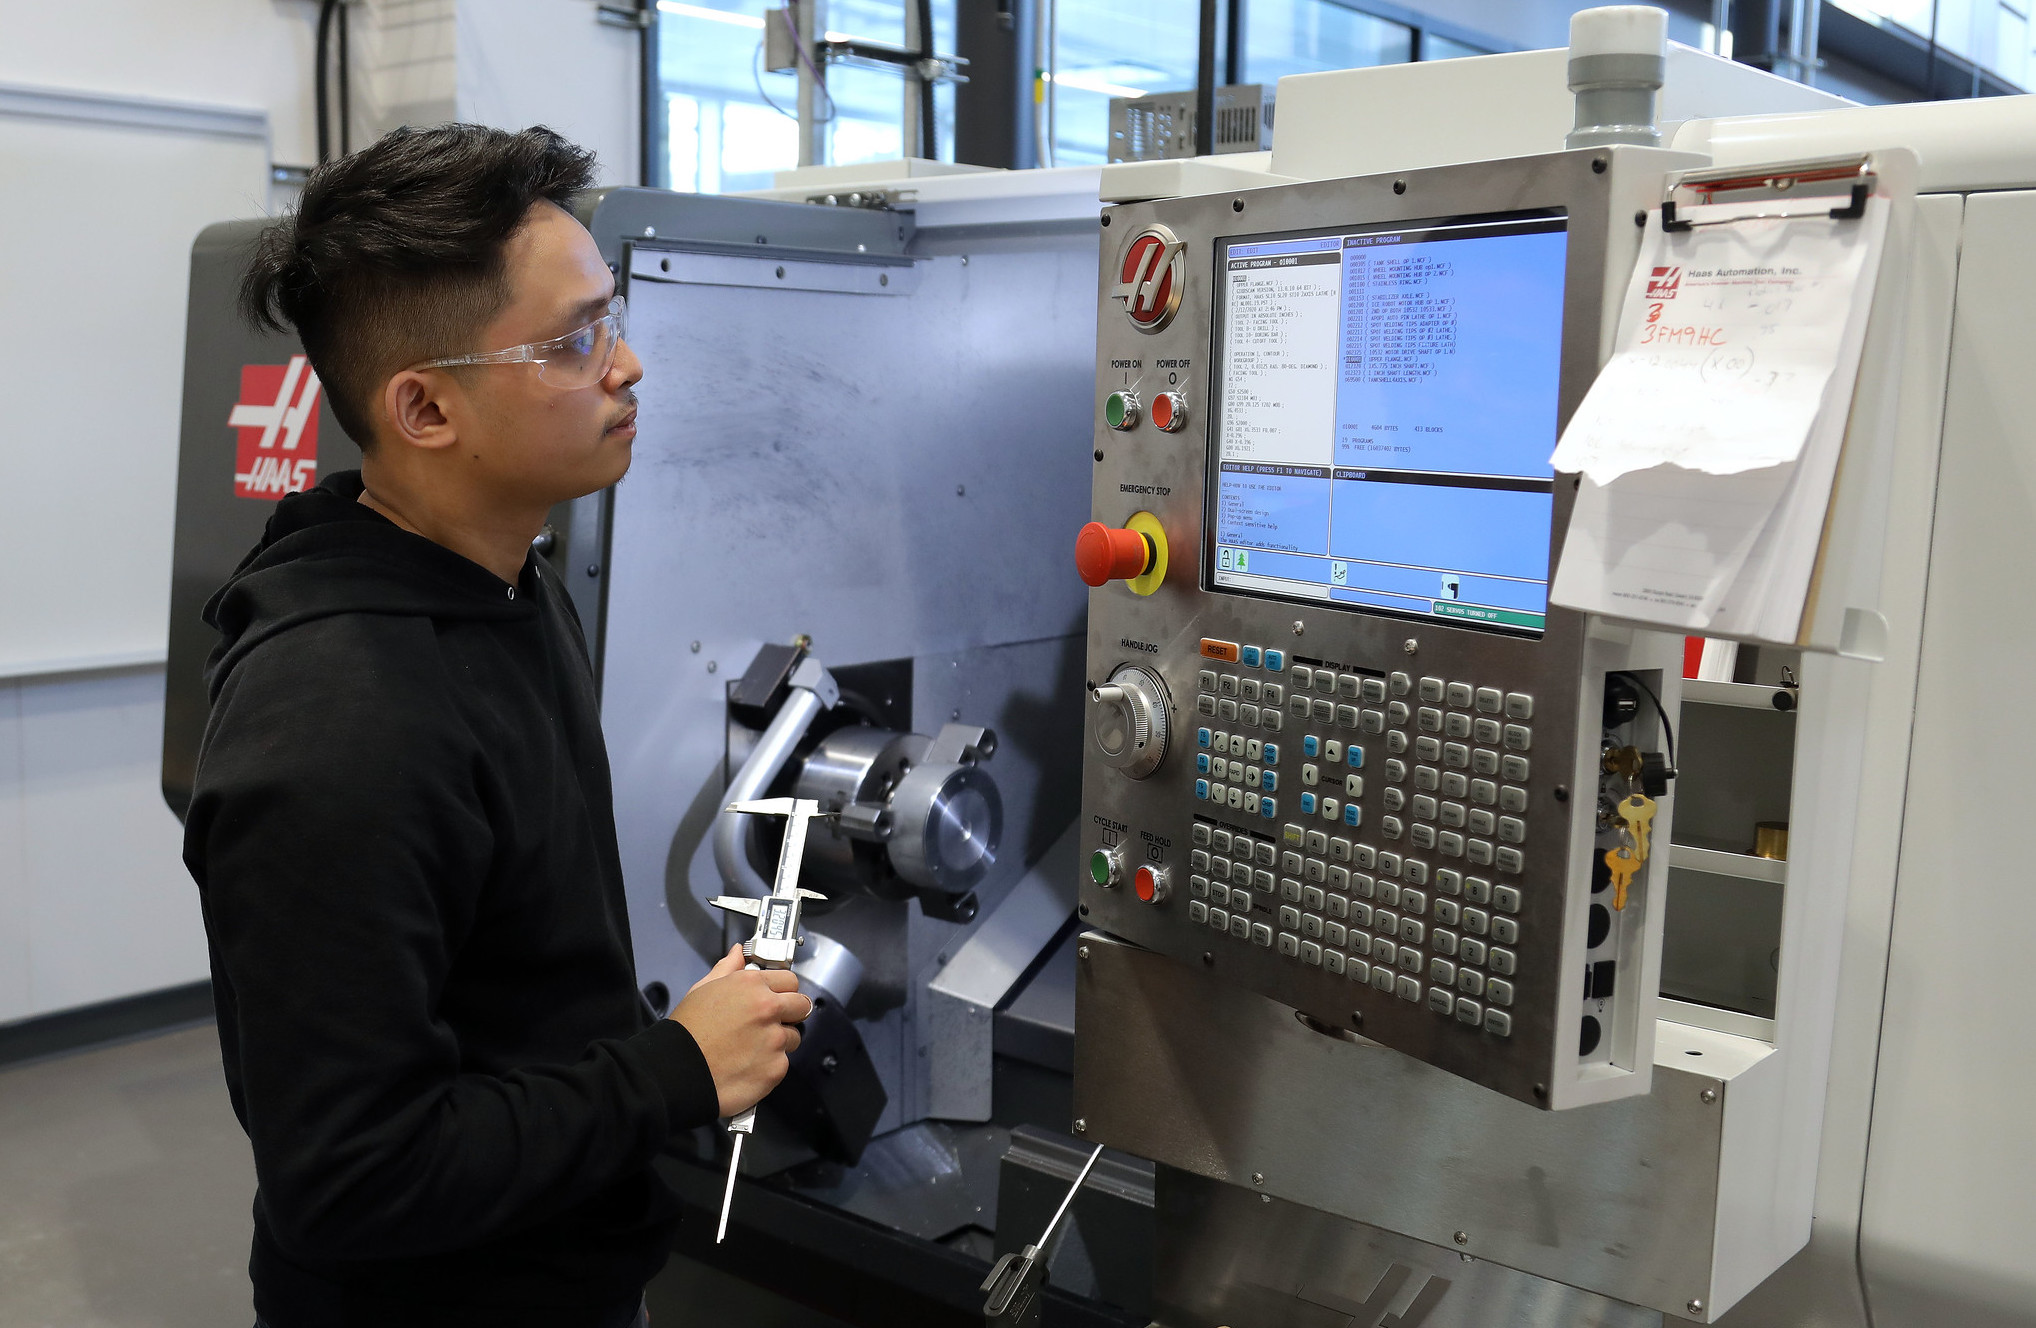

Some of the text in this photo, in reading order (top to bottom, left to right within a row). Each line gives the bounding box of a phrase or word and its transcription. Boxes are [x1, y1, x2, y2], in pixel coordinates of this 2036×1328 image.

[1347, 238, 1373, 246] INACTIVE
[1231, 261, 1248, 269] ACTIVE
[1250, 259, 1272, 267] PROGRAM
[1688, 267, 1802, 278] Haas Automation, Inc.
[1646, 289, 1678, 299] HAAS
[1641, 324, 1728, 346] 3FM9HC
[1111, 359, 1142, 368] POWER ON
[1156, 359, 1190, 368] POWER OFF
[235, 457, 317, 493] HAAS
[1256, 466, 1274, 474] (PRESS
[1294, 468, 1322, 477] NAVIGATE)
[1120, 484, 1171, 496] EMERGENCY STOP
[1446, 606, 1465, 615] SERVOS
[1467, 609, 1486, 617] TURNED
[1487, 611, 1497, 619] OFF
[1121, 639, 1158, 654] HANDLE JOG
[1207, 645, 1227, 656] RESET
[1325, 661, 1351, 672] DISPLAY
[1203, 677, 1209, 685] F1
[1224, 681, 1230, 689] F2
[1245, 686, 1252, 694] F3
[1267, 690, 1275, 698] F4
[1322, 776, 1342, 786] CURSOR
[1094, 815, 1128, 833] CYCLE START
[1220, 822, 1248, 835] OVERRIDES
[1140, 831, 1171, 848] FEED HOLD
[1285, 832, 1299, 841] SHIFT
[1360, 853, 1366, 862] C
[1385, 860, 1390, 868] D
[1311, 867, 1316, 875] G
[1411, 868, 1416, 876] E
[1334, 874, 1340, 883] H
[1473, 887, 1477, 895] 8
[1234, 897, 1244, 905] REV
[1310, 894, 1315, 902] M
[1409, 898, 1414, 906] K
[1502, 896, 1507, 904] 9
[1253, 903, 1271, 914] SPINDLE
[1333, 902, 1338, 910] N
[1286, 915, 1291, 923] R
[1382, 918, 1387, 926] P
[1470, 917, 1475, 926] 5
[1309, 922, 1313, 931] S
[1500, 927, 1505, 935] 6
[1407, 927, 1413, 936] Q
[1284, 941, 1288, 950] X
[1307, 950, 1311, 958] Y
[1380, 947, 1385, 956] V
[1468, 948, 1473, 956] 2
[1330, 958, 1335, 967] Z
[1404, 956, 1412, 965] W
[1498, 957, 1503, 966] 3
[1430, 996, 1447, 1007] CANCEL
